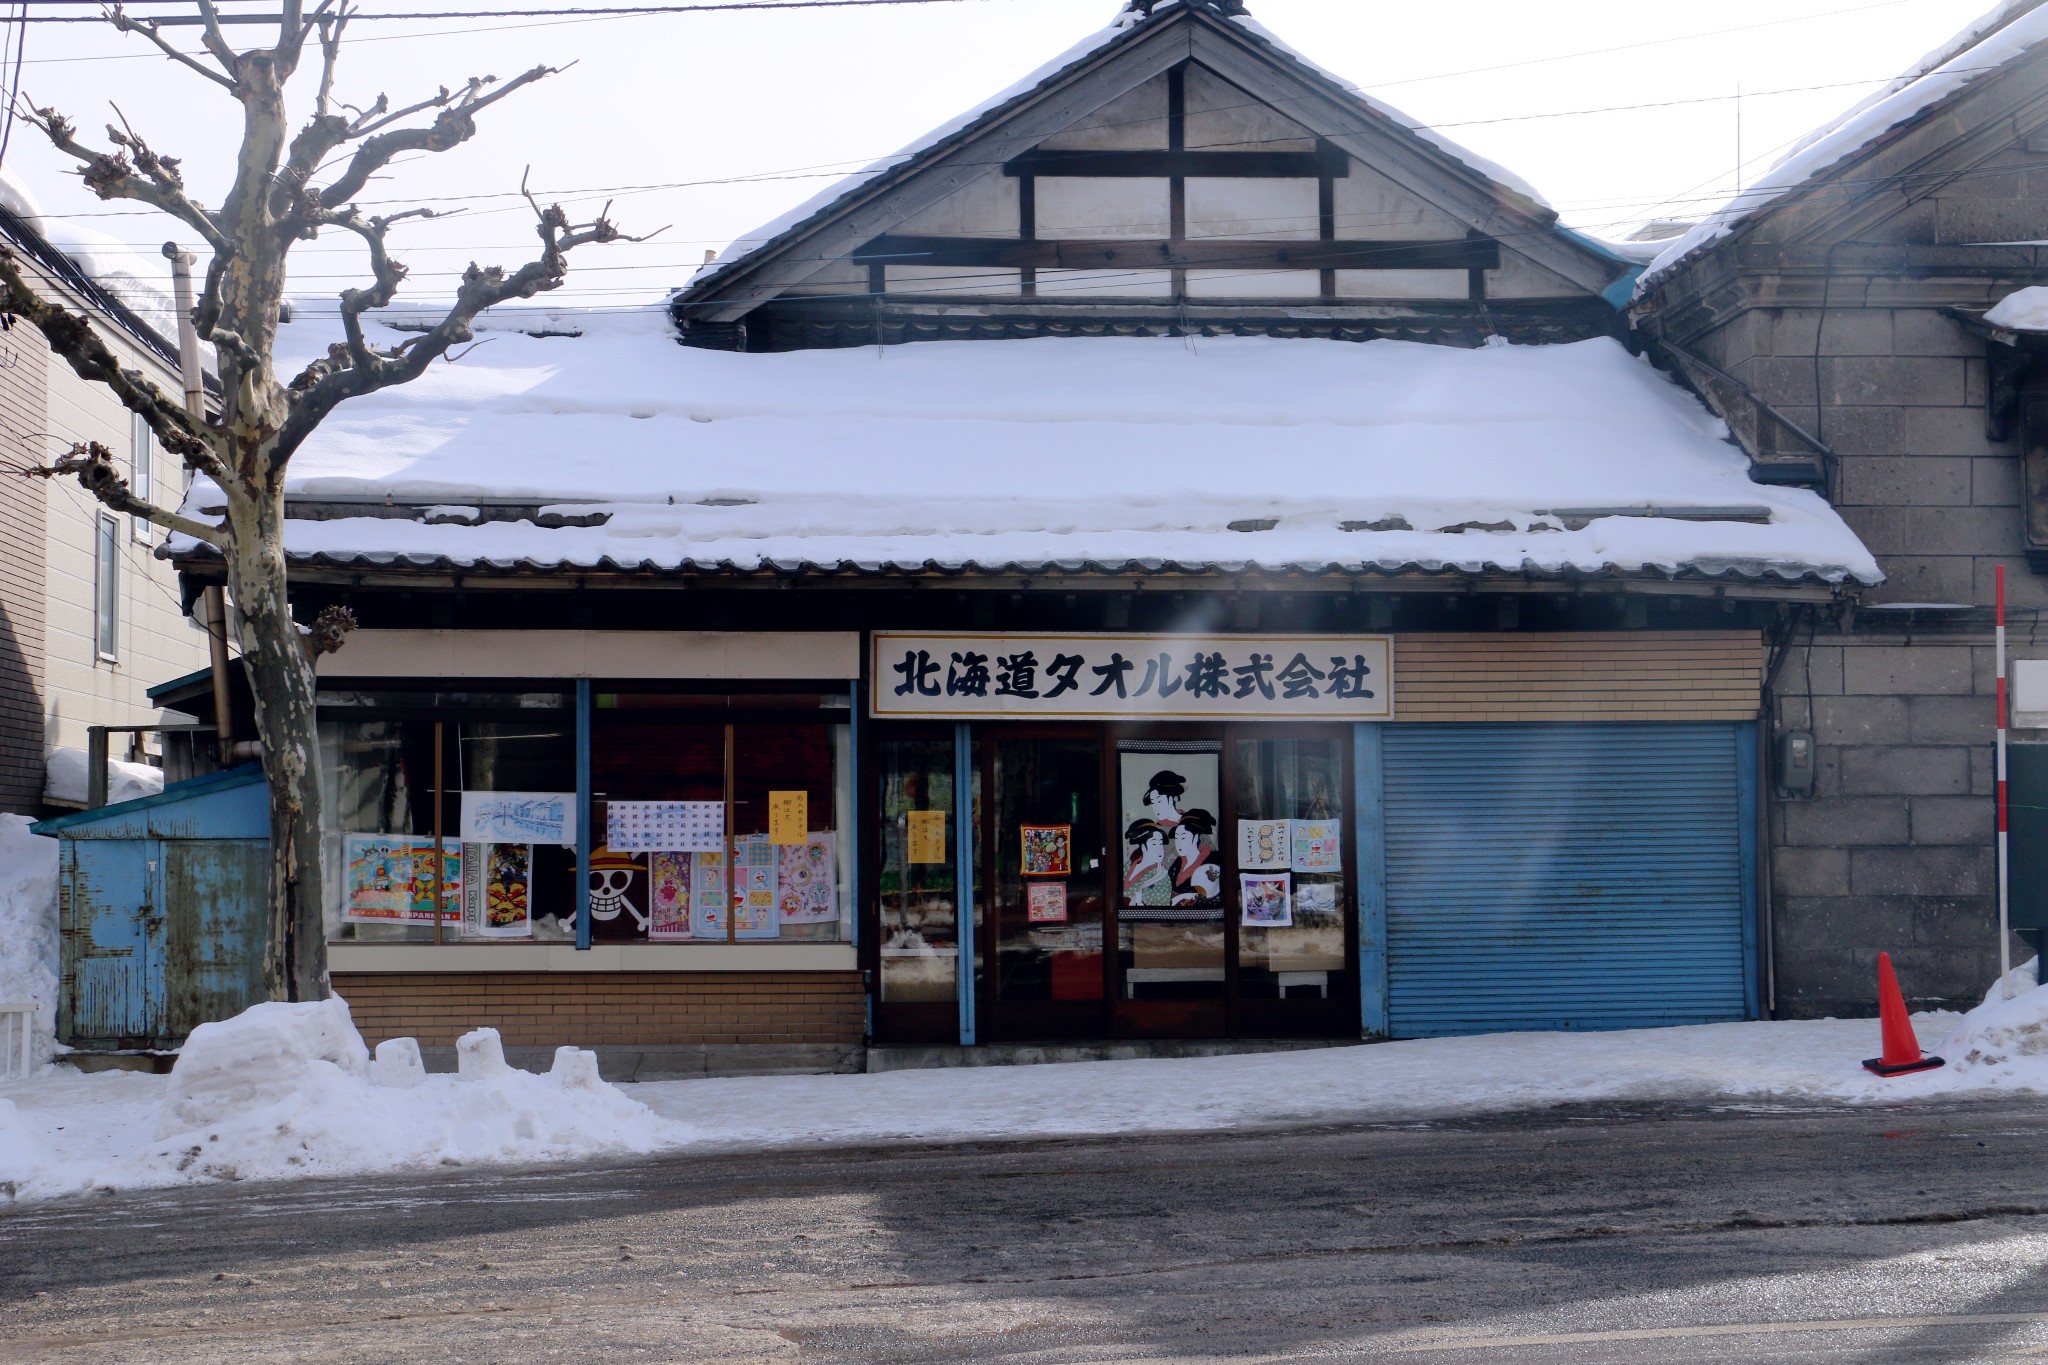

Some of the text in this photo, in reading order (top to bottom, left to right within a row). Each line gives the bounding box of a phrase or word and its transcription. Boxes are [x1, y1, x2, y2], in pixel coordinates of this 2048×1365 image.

[893, 650, 1375, 700] 北海道タオル株式会社
[771, 803, 780, 835] 承ります
[783, 799, 792, 821] 御注文
[796, 794, 804, 838] 名入れタオル
[467, 890, 477, 932] Kappa
